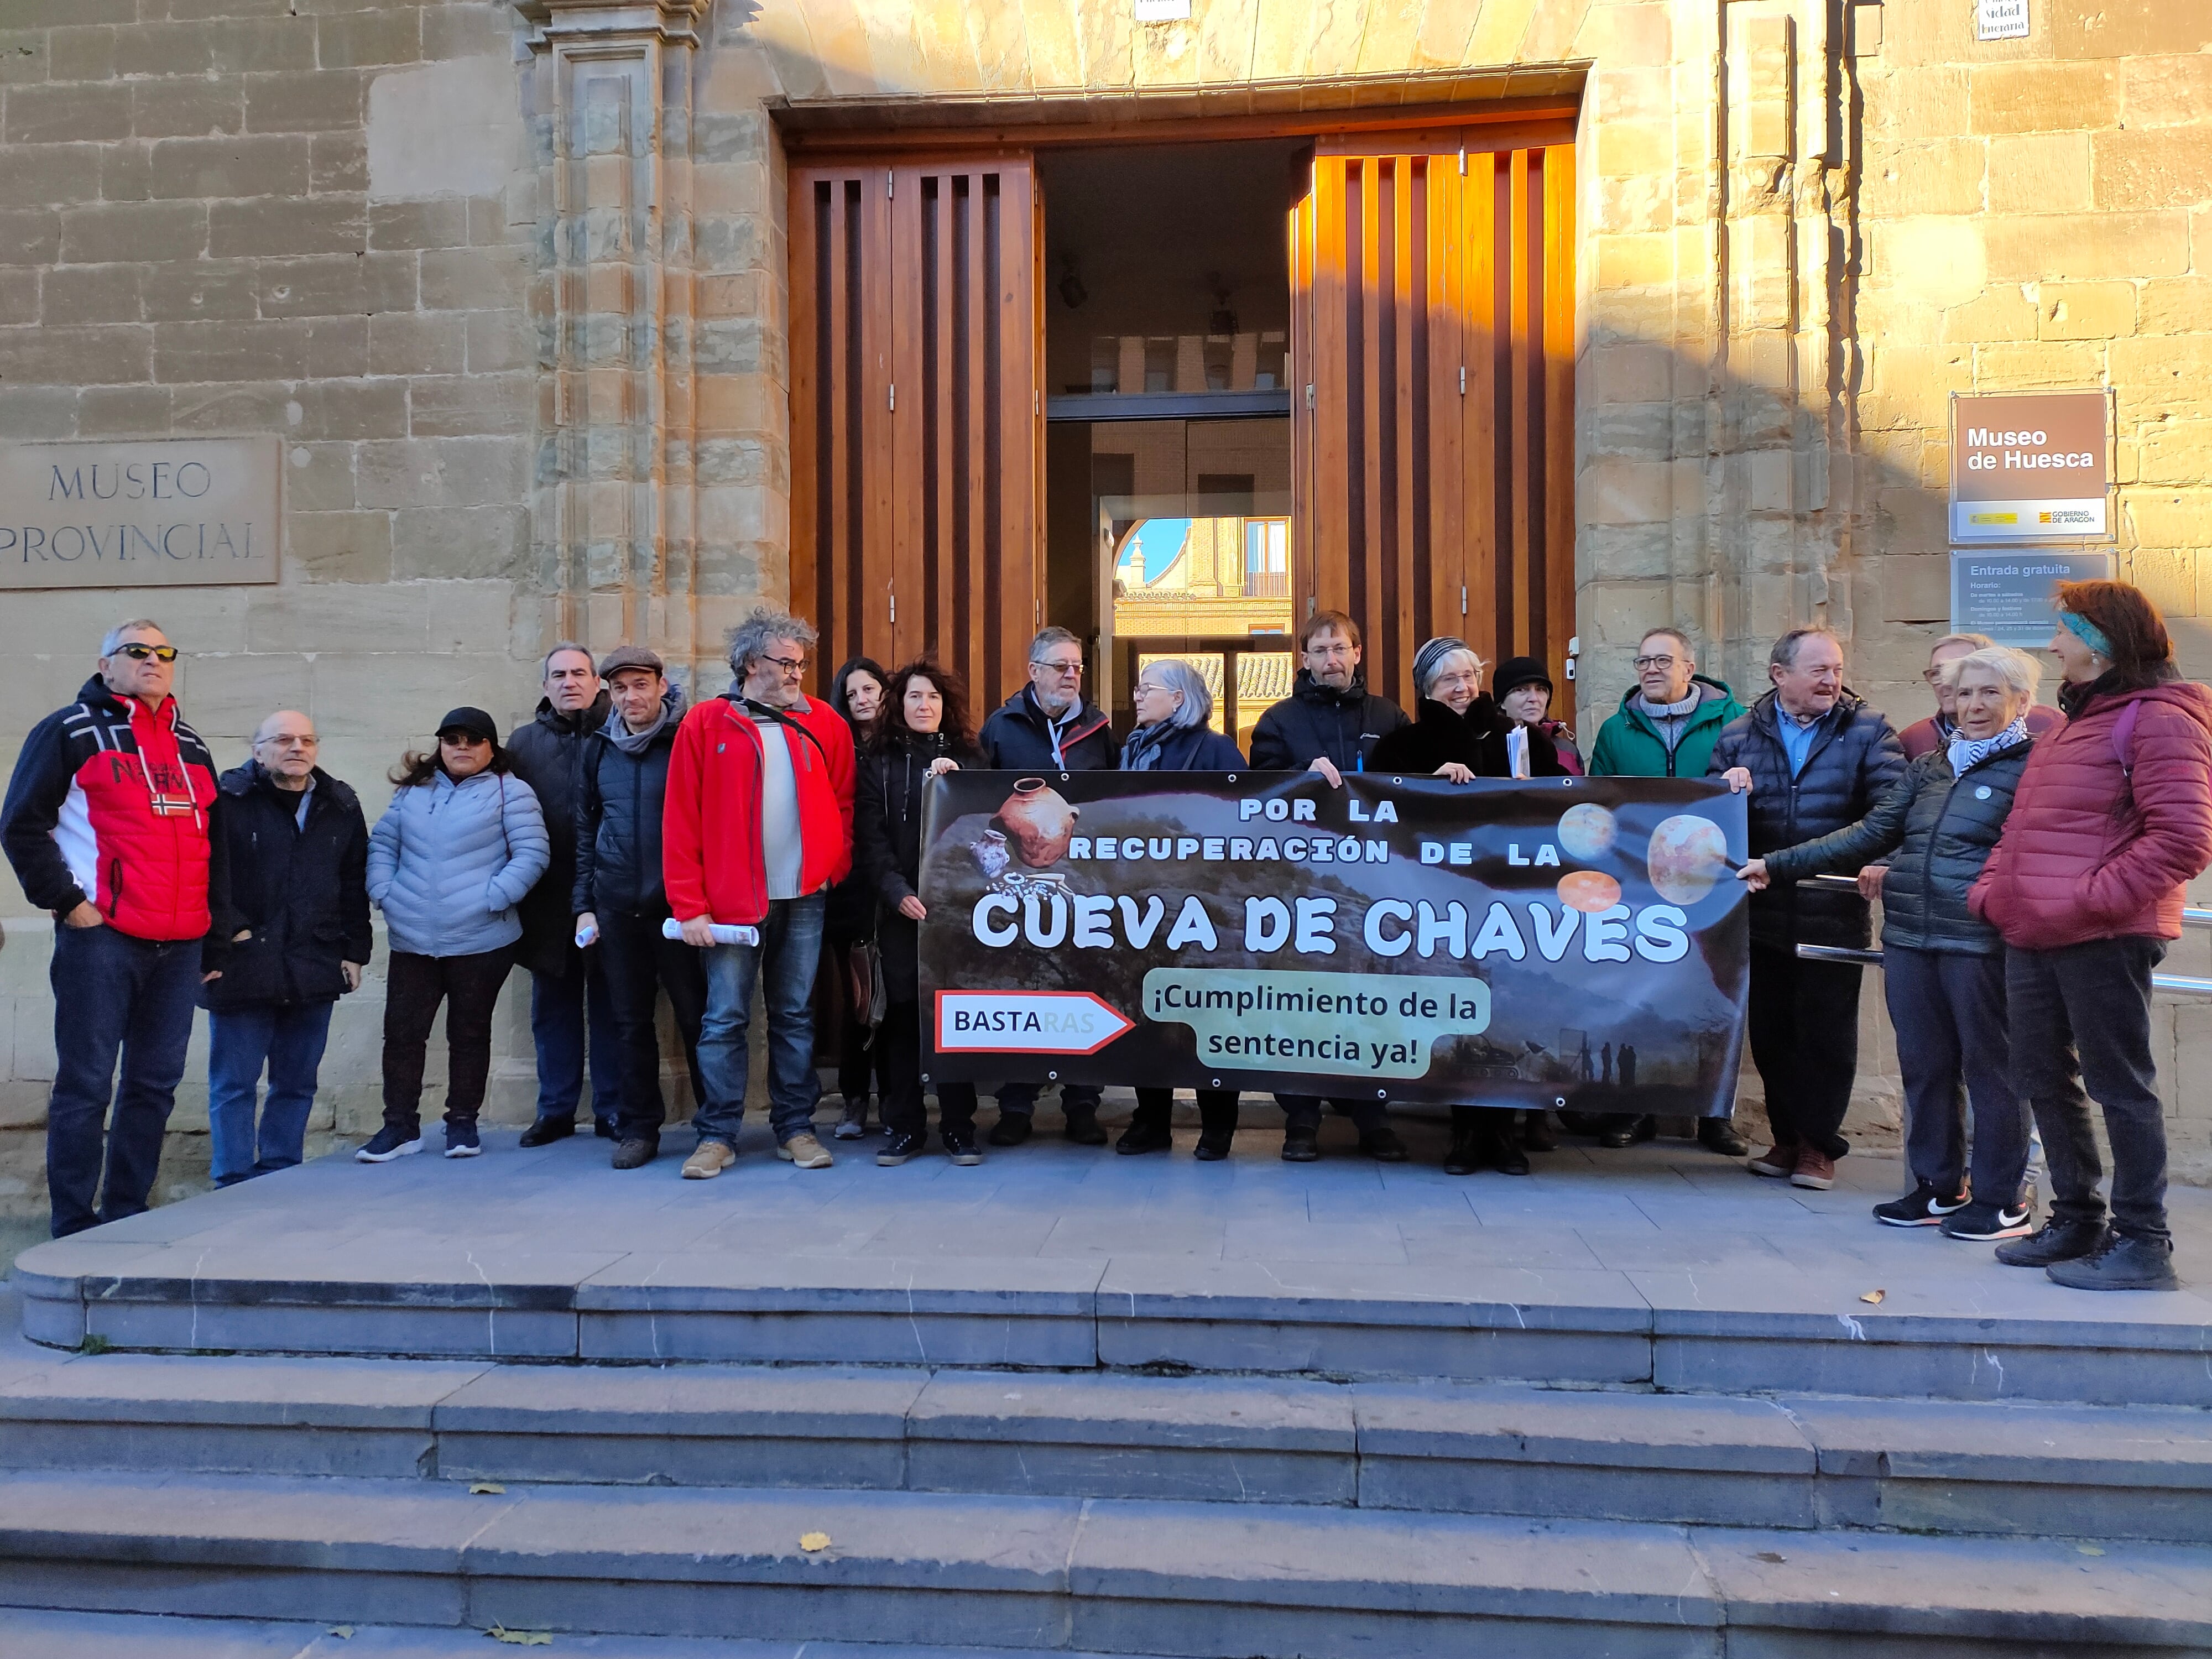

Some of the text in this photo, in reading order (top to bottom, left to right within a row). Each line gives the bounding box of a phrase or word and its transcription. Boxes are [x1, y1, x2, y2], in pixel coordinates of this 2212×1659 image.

[1968, 428, 2047, 447] Museo
[1968, 450, 2094, 470] de Huesca
[49, 462, 211, 500] MUSEO
[1971, 564, 2070, 577] Entrada gratuita
[1240, 799, 1399, 822] POR LA
[1069, 836, 1561, 866] RECUPERACIÓN DE LA
[972, 894, 1689, 963] CUEVA DE CHAVES
[1155, 984, 1477, 1019] ¡Cumplimiento de la
[1209, 1034, 1417, 1070] sentencia ya!
